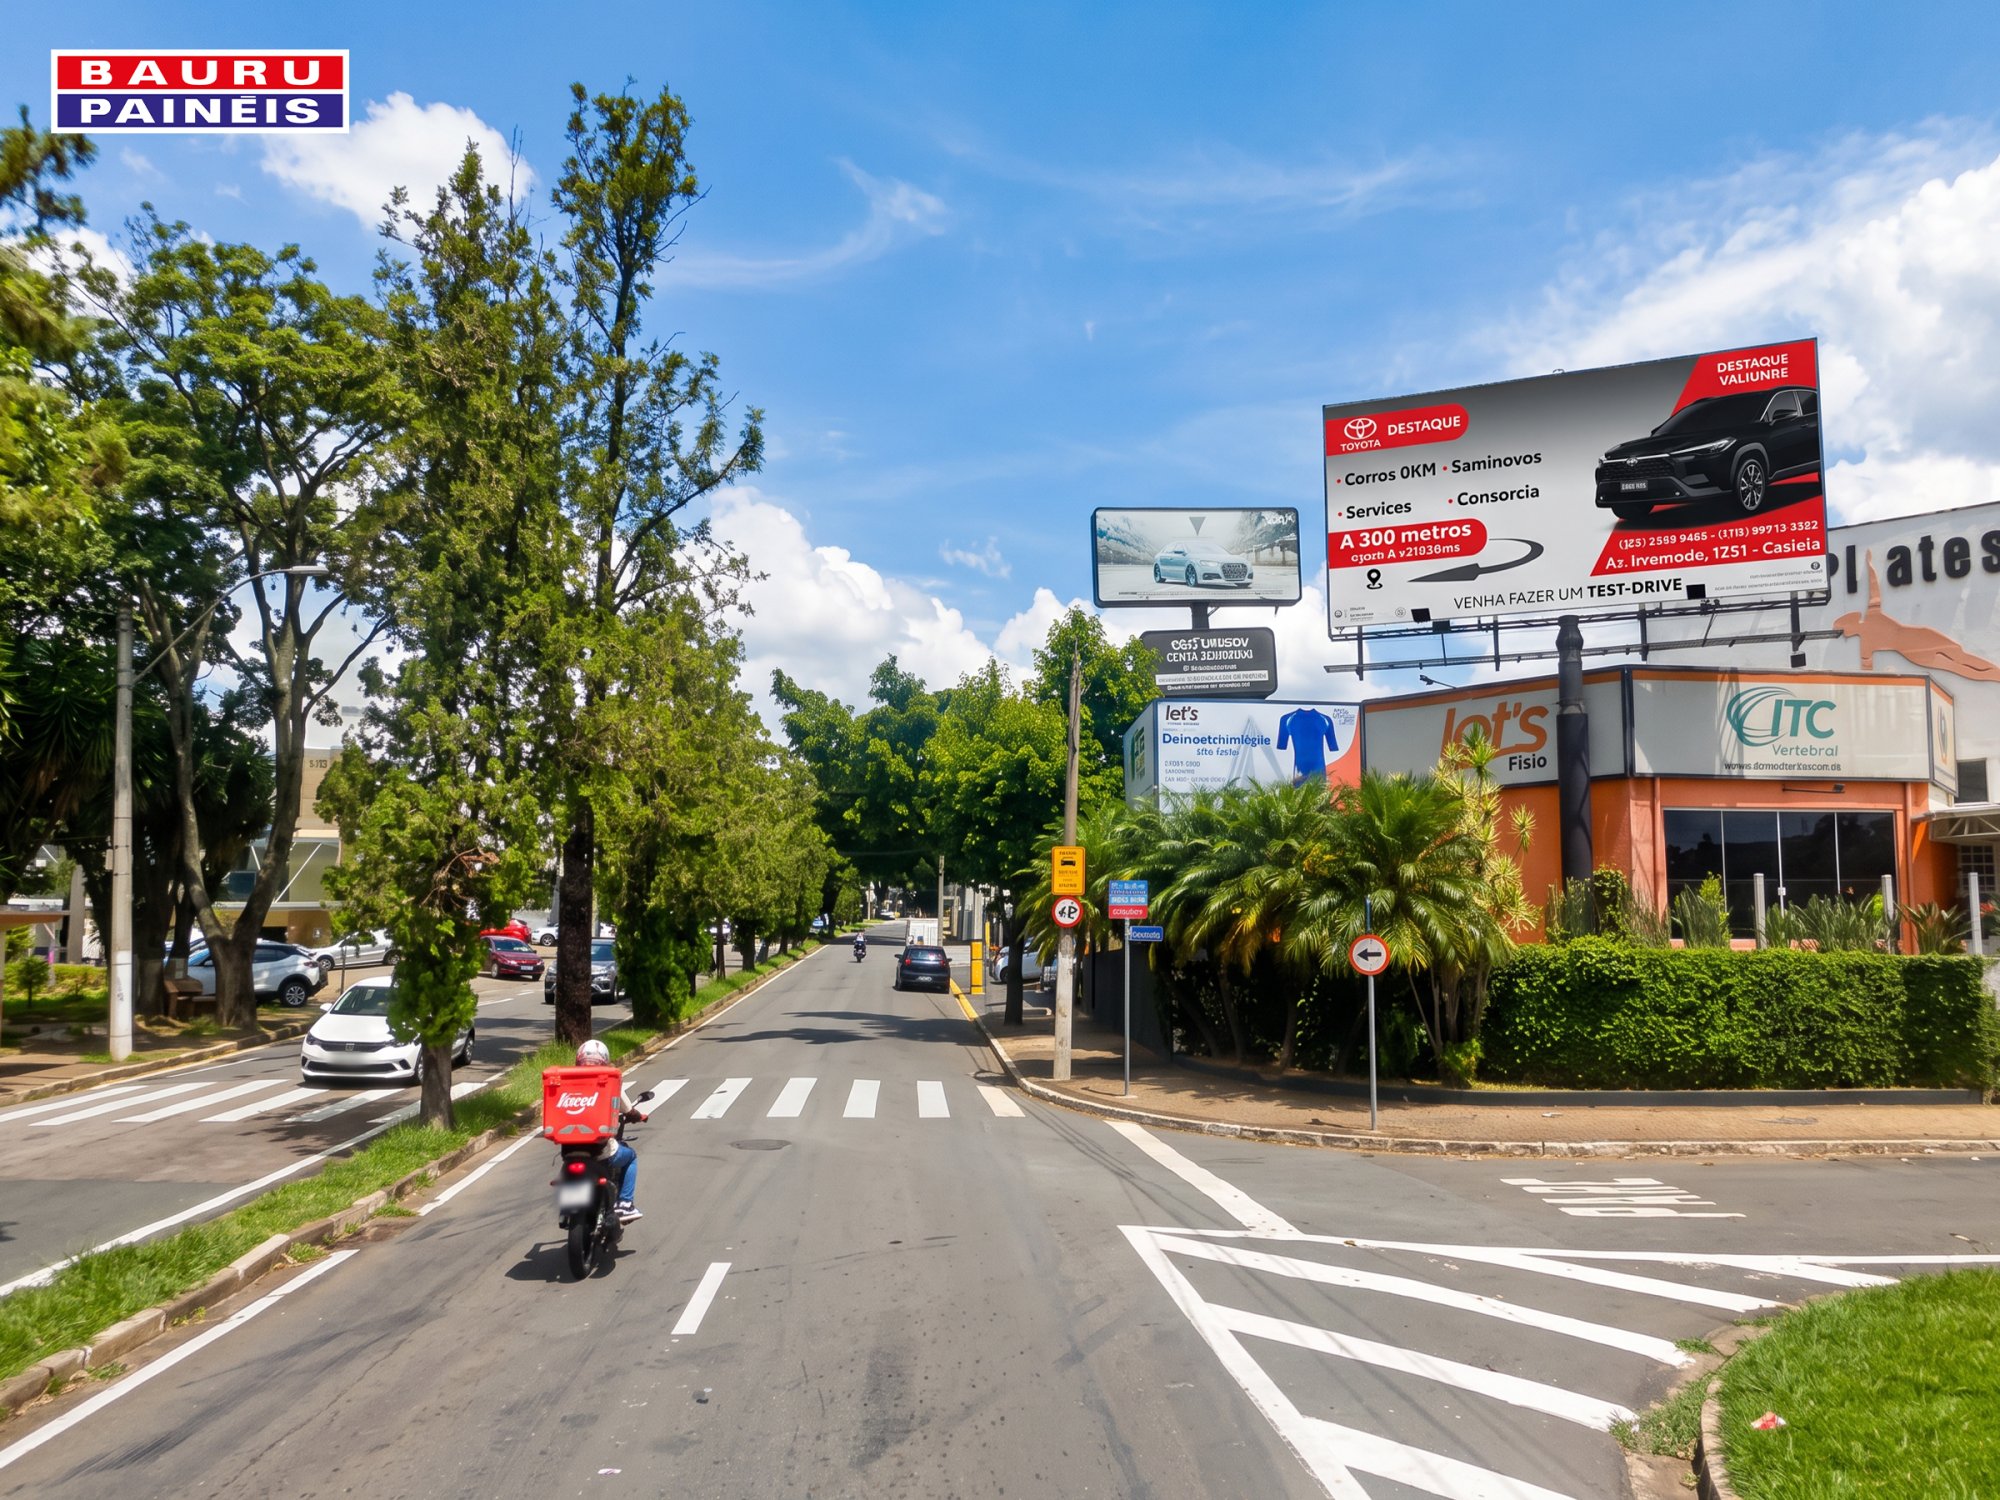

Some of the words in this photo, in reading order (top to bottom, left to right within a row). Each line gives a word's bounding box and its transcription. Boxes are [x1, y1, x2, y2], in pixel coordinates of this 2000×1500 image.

[1717, 353, 1788, 373] DESTAQUE
[1387, 415, 1461, 436] DESTAQUE
[1340, 439, 1381, 451] TOYOTA
[1345, 470, 1396, 486] Corros
[1451, 452, 1542, 473] Saminovos
[1346, 501, 1412, 519] Services
[1457, 485, 1540, 506] Consorcia
[1340, 534, 1354, 550] A
[1359, 529, 1396, 547] 300
[1401, 523, 1472, 543] metros
[1453, 593, 1505, 610] VENHA
[1509, 589, 1554, 605] FAZER
[1558, 586, 1583, 601] UM
[1587, 578, 1682, 598] TEST-DRIVE
[1165, 705, 1199, 721] let's
[1770, 699, 1837, 739] ITC
[1772, 744, 1838, 757] Vertebral
[1509, 753, 1547, 771] Fisio
